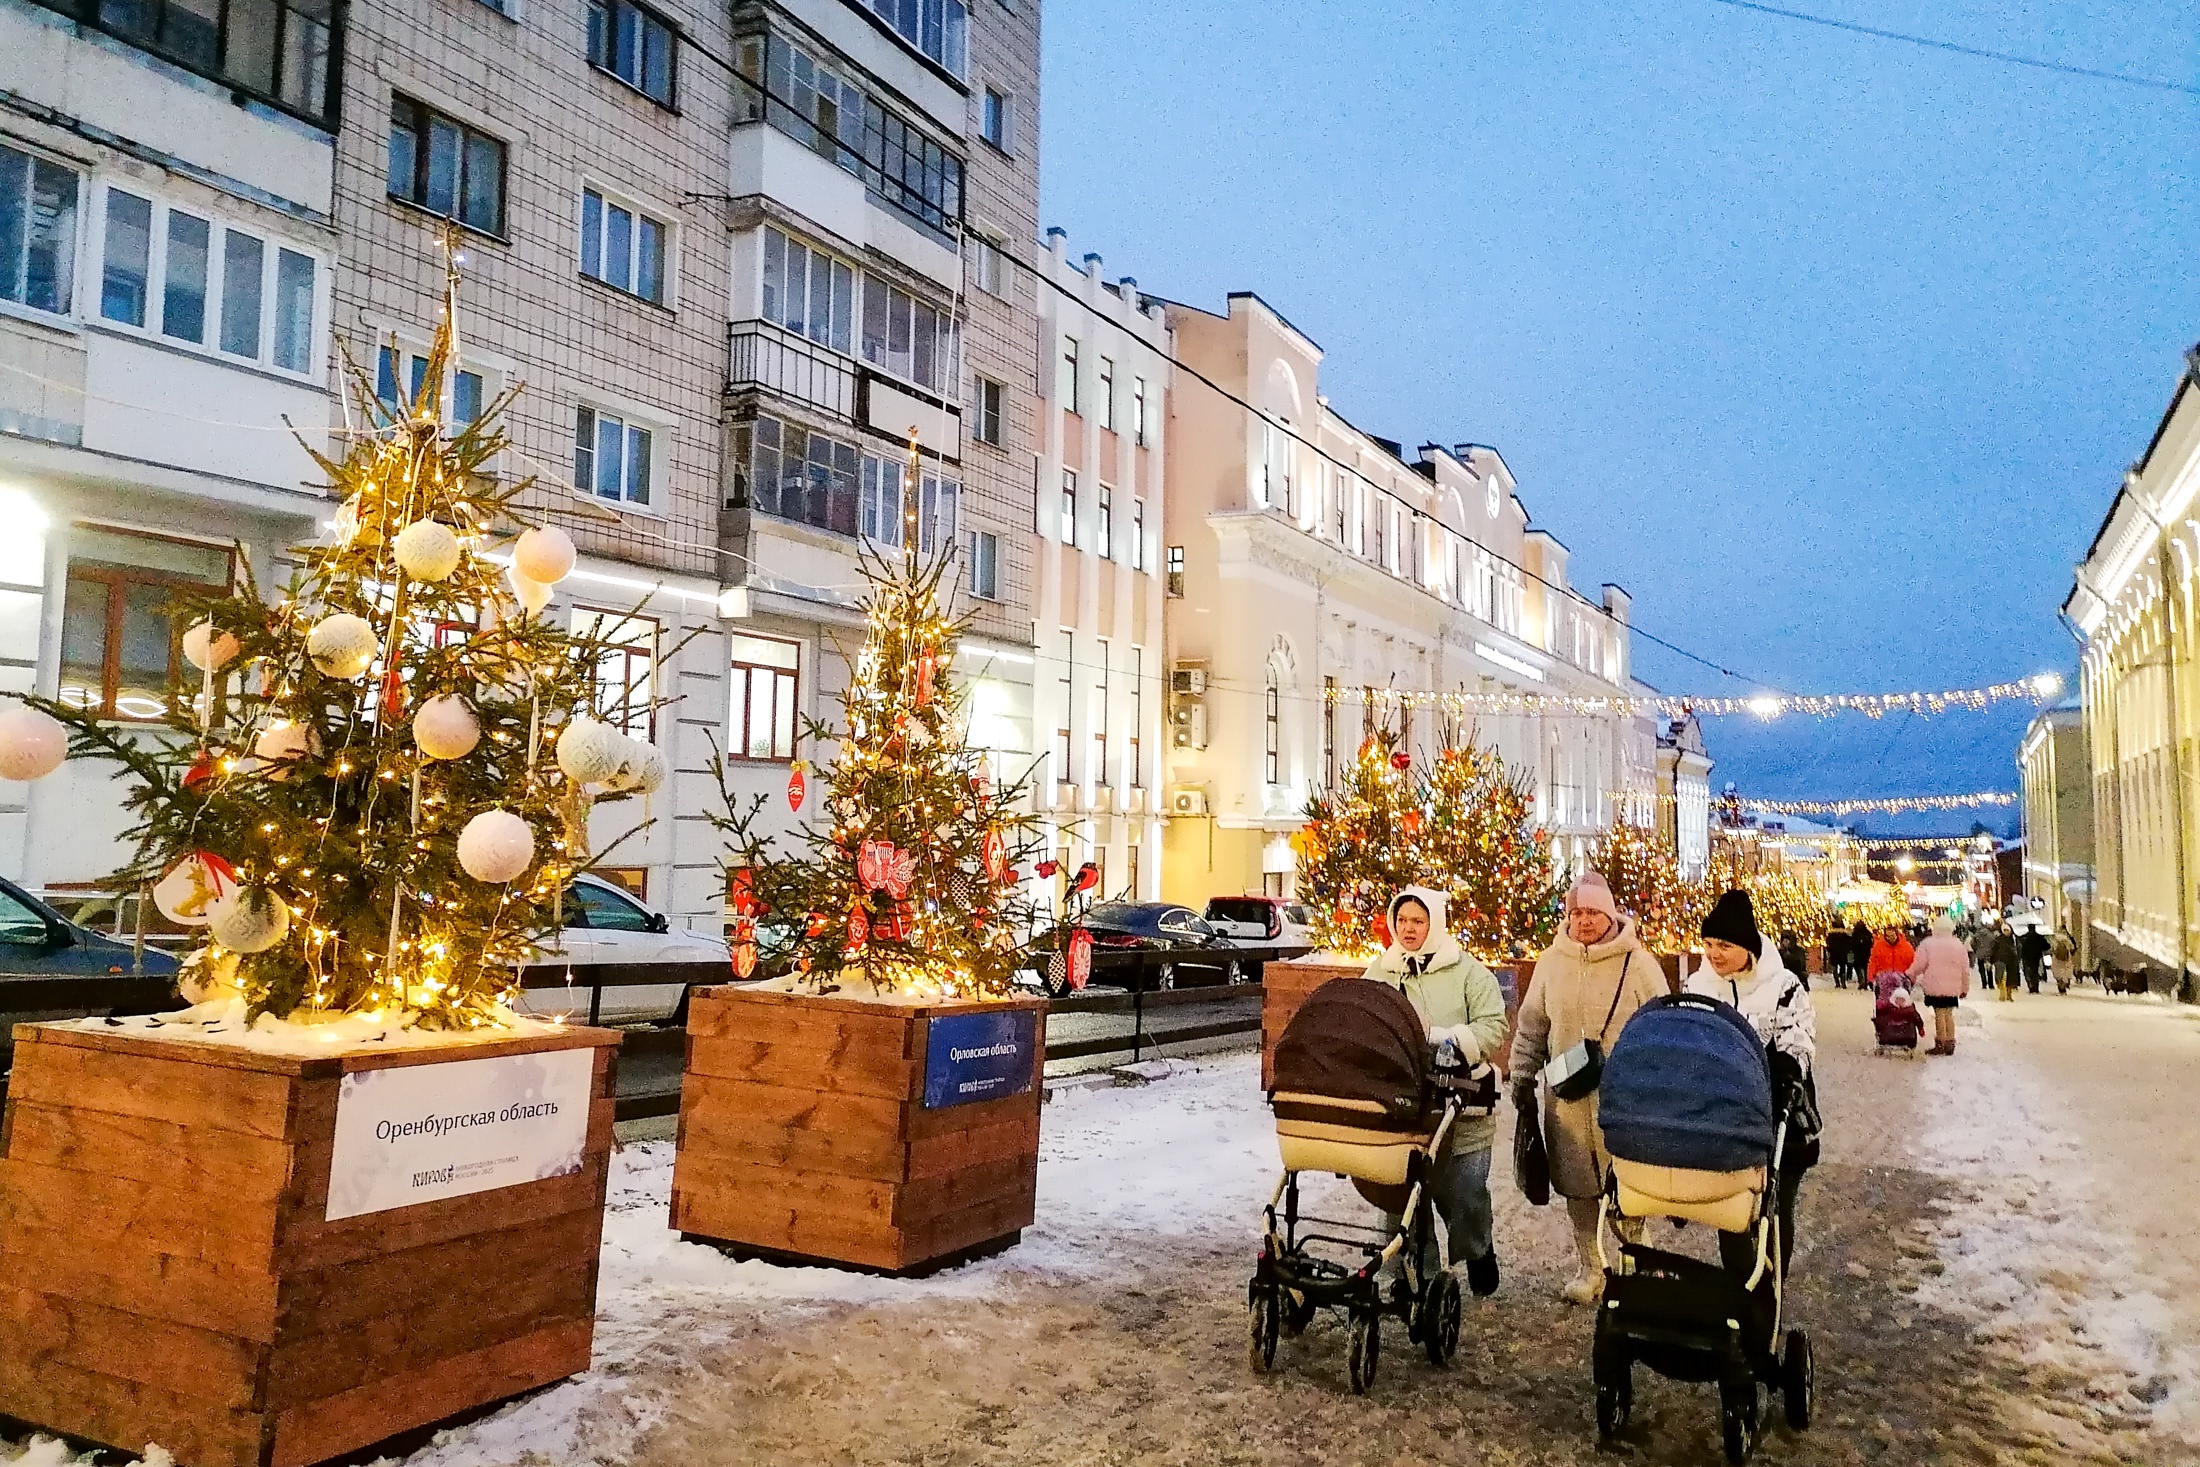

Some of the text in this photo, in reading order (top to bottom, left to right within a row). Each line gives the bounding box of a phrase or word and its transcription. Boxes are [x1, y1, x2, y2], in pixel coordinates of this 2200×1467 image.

[950, 1042, 1017, 1064] Орловская область
[375, 1102, 559, 1144] Оренбургская область
[412, 1168, 447, 1187] КИРОВ
